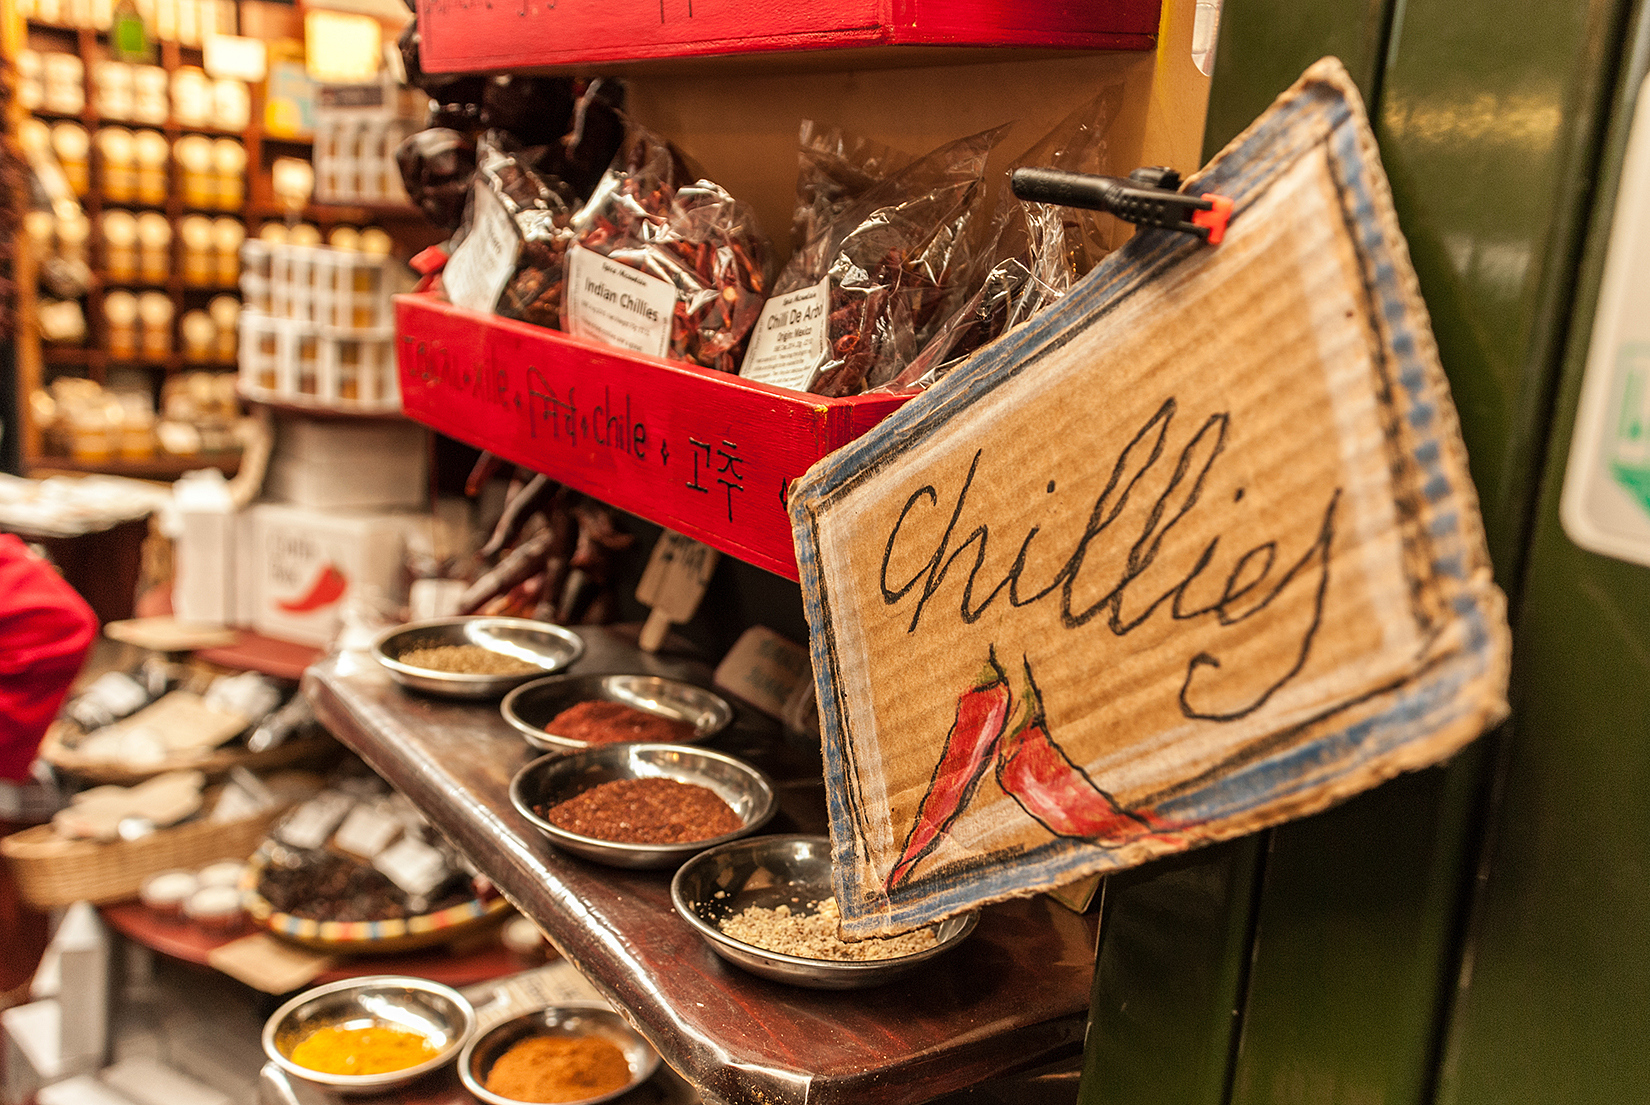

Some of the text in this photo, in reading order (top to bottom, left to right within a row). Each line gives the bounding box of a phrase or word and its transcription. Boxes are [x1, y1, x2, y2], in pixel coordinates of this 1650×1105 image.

[584, 277, 617, 304] Indian
[619, 293, 659, 322] Chillies
[790, 308, 802, 325] De
[593, 385, 646, 459] chile
[685, 436, 744, 524] 고추
